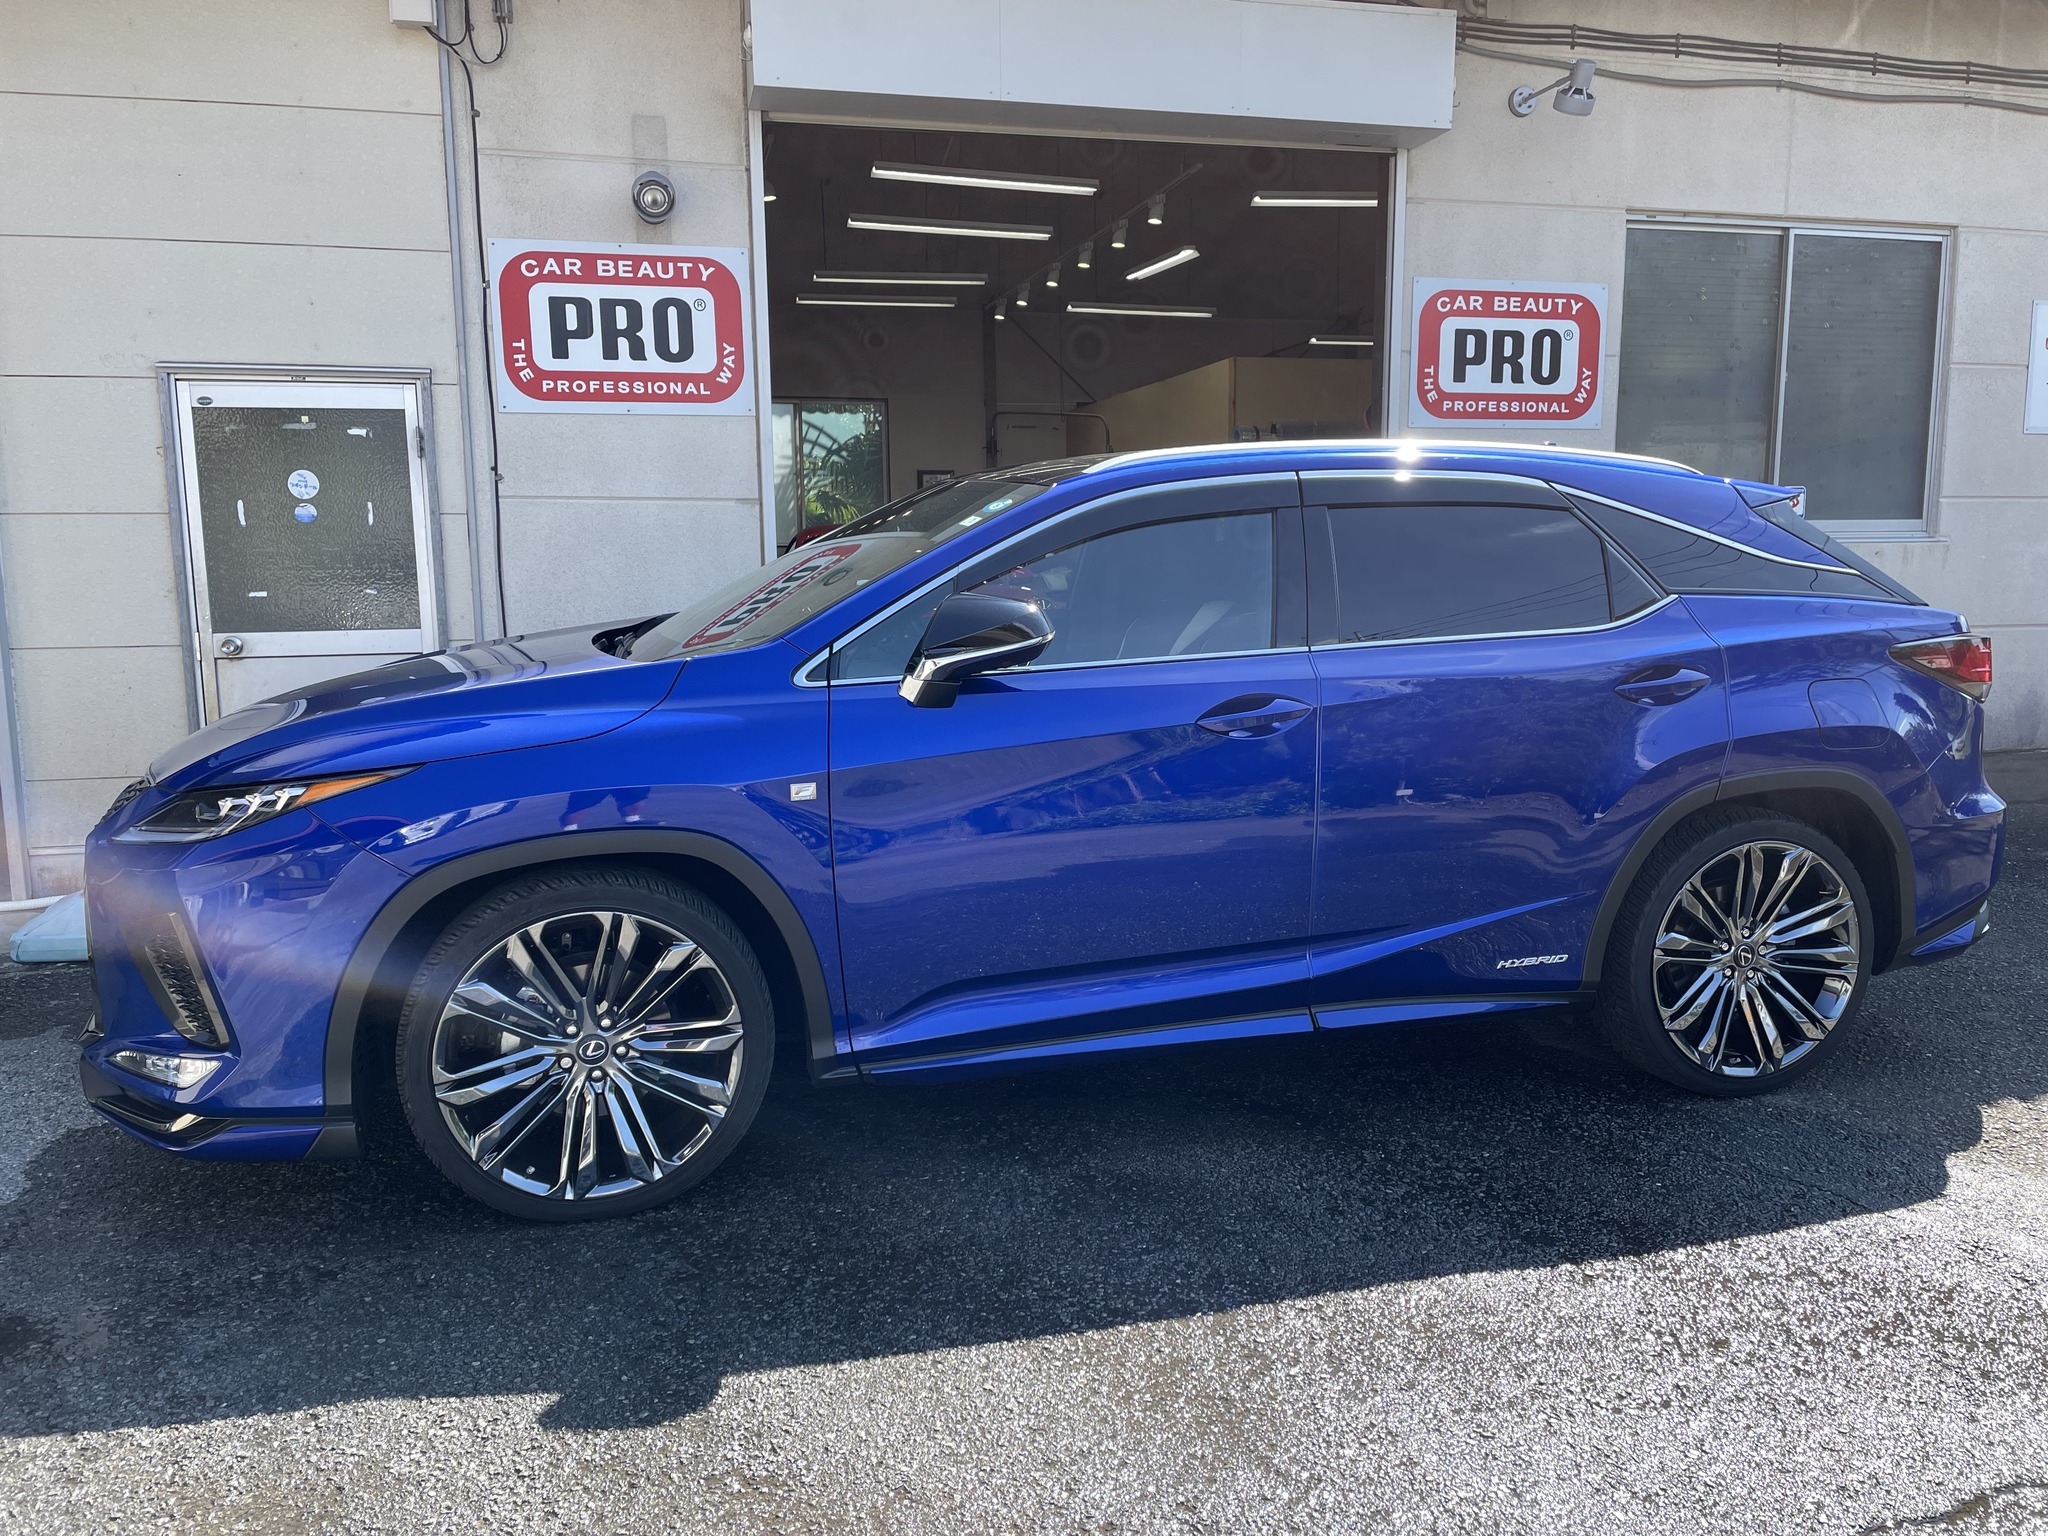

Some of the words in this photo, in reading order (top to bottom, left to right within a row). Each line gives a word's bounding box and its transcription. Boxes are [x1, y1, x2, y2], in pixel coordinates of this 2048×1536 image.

[520, 257, 582, 277] CAR
[596, 259, 716, 282] BEAUTY
[547, 295, 695, 363] PRO
[1436, 295, 1484, 313] CAR
[1493, 296, 1584, 316] BEAUTY
[511, 338, 535, 383] THE
[541, 380, 711, 396] PROFESSIONAL
[715, 342, 736, 385] WAY
[1452, 328, 1563, 386] PRO
[1423, 365, 1439, 404] THE
[1442, 400, 1570, 413] PROFESSIONAL
[1574, 367, 1592, 405] WAY
[1496, 954, 1569, 970] HYBRID
